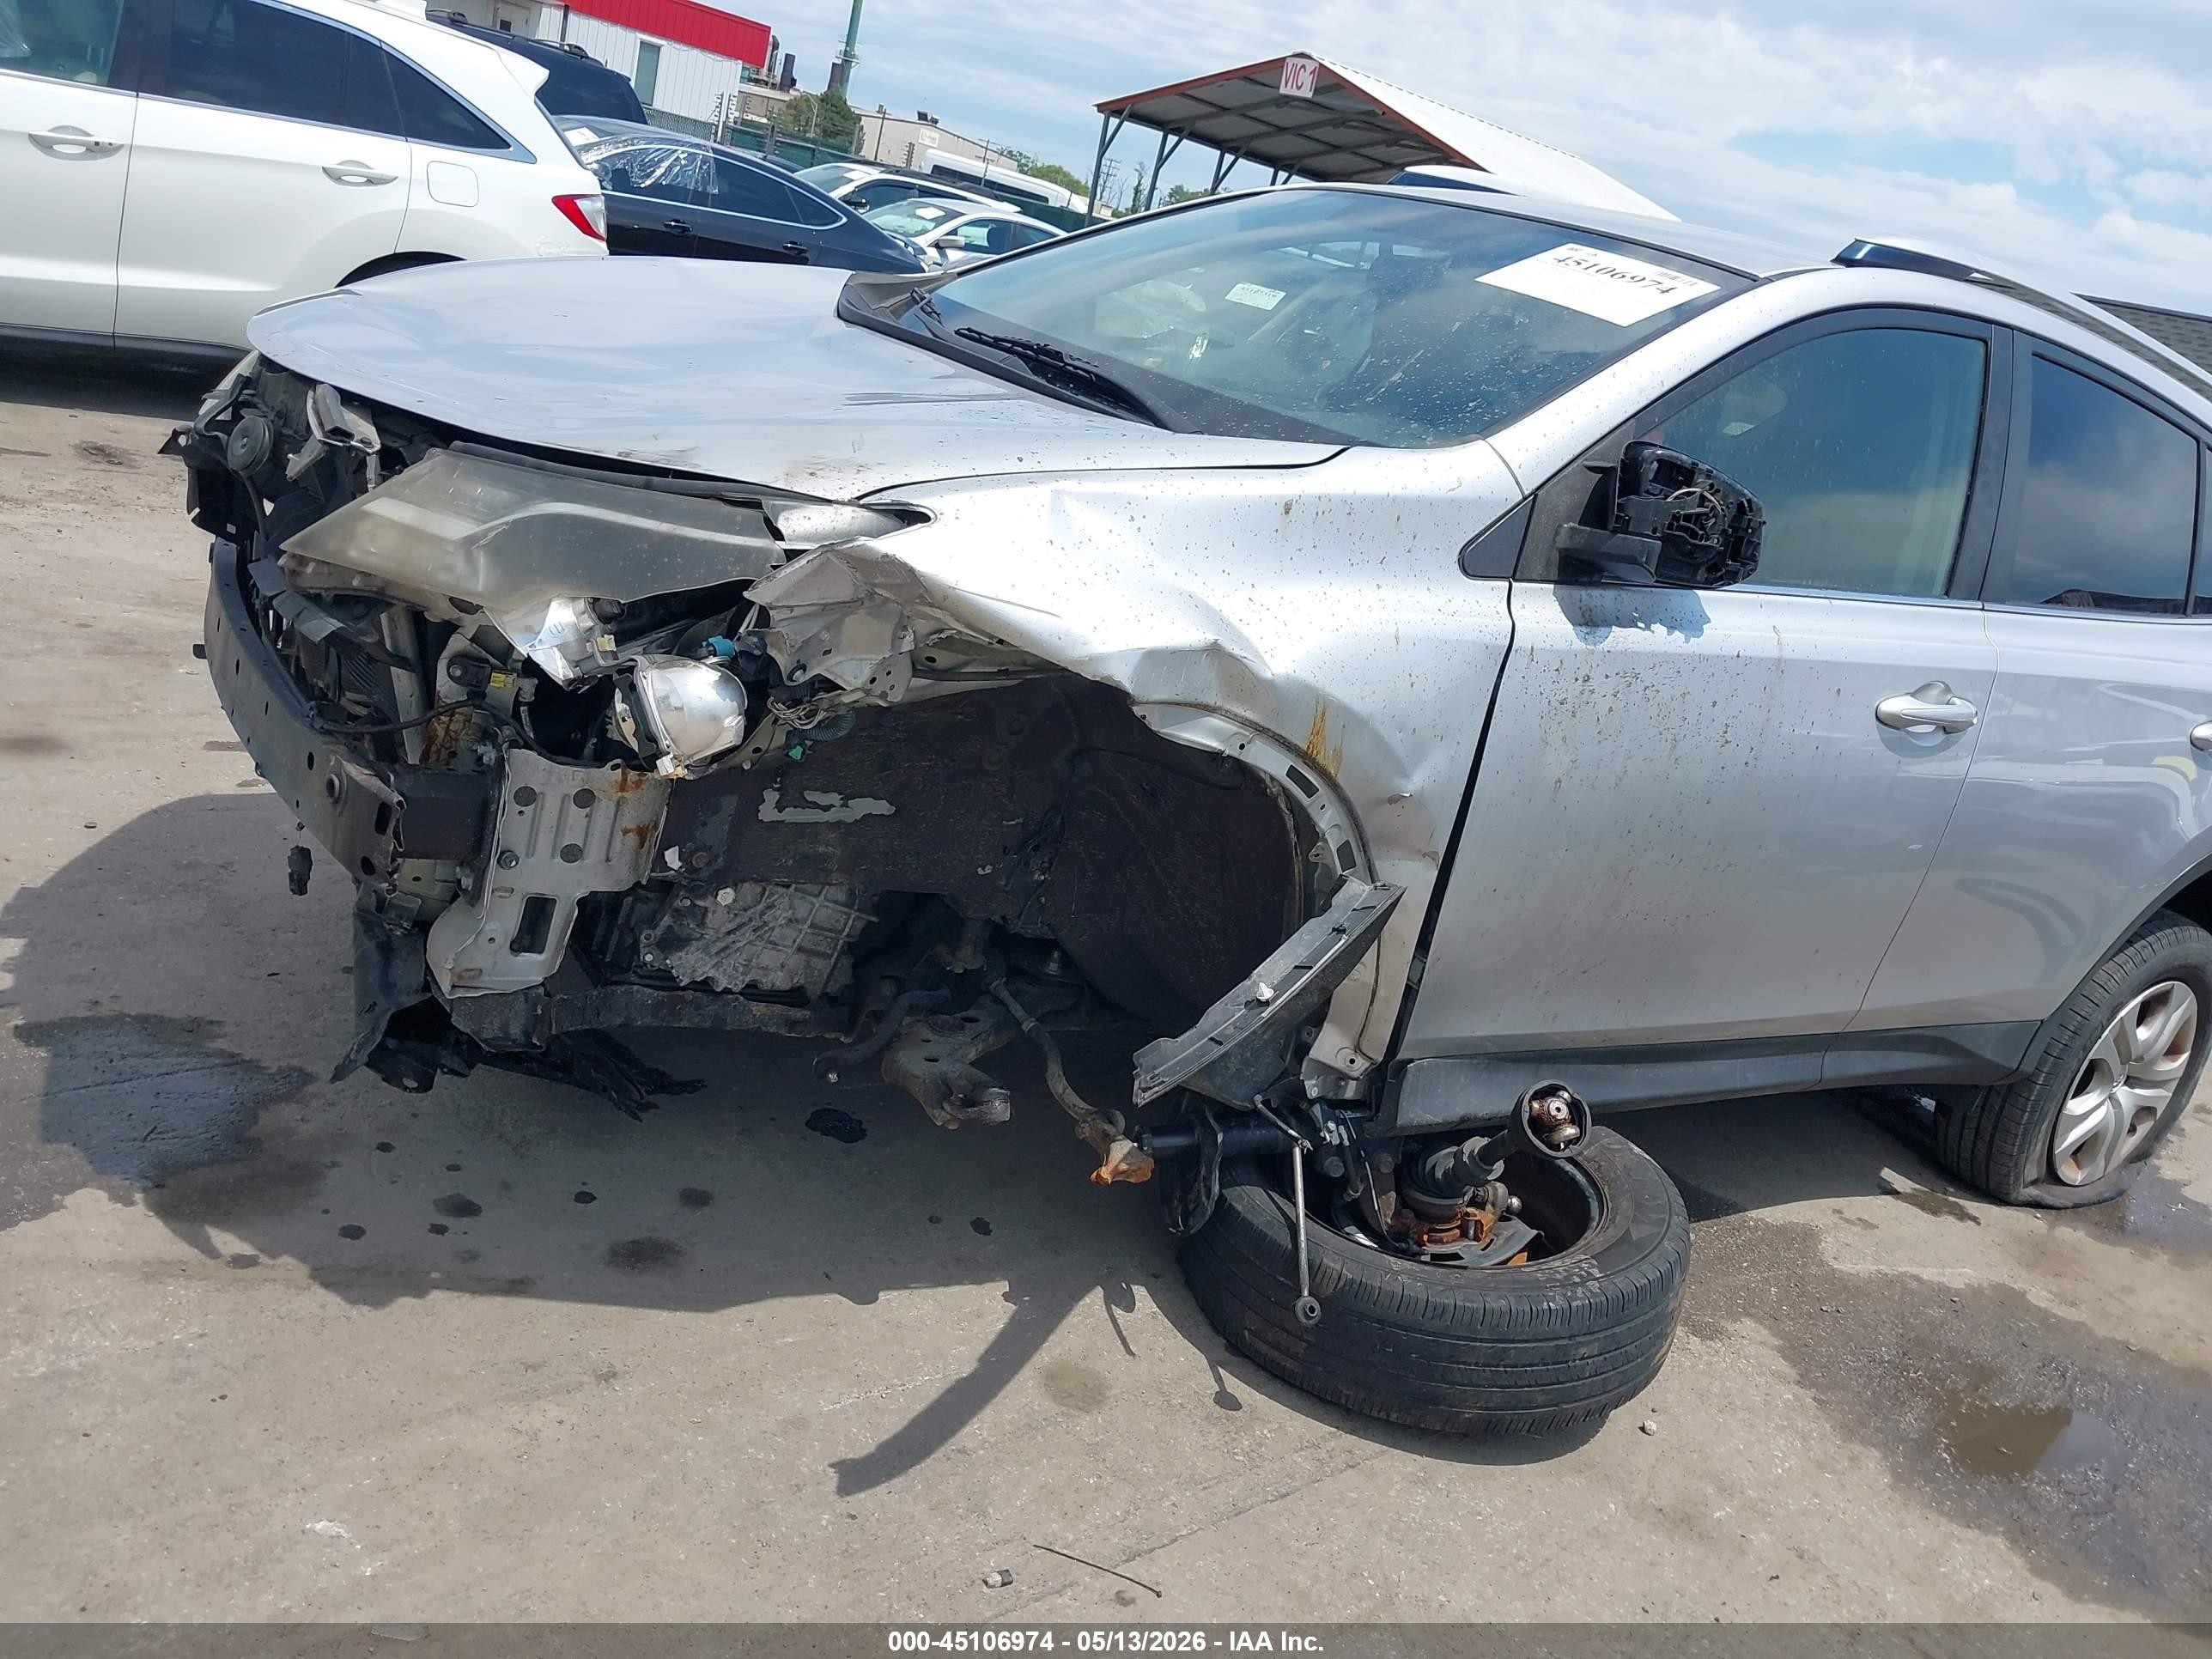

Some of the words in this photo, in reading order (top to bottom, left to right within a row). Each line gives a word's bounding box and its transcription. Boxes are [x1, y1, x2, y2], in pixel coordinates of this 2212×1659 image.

[1284, 61, 1306, 91] VIC
[1309, 65, 1317, 93] 1
[1553, 255, 1680, 295] 45106974
